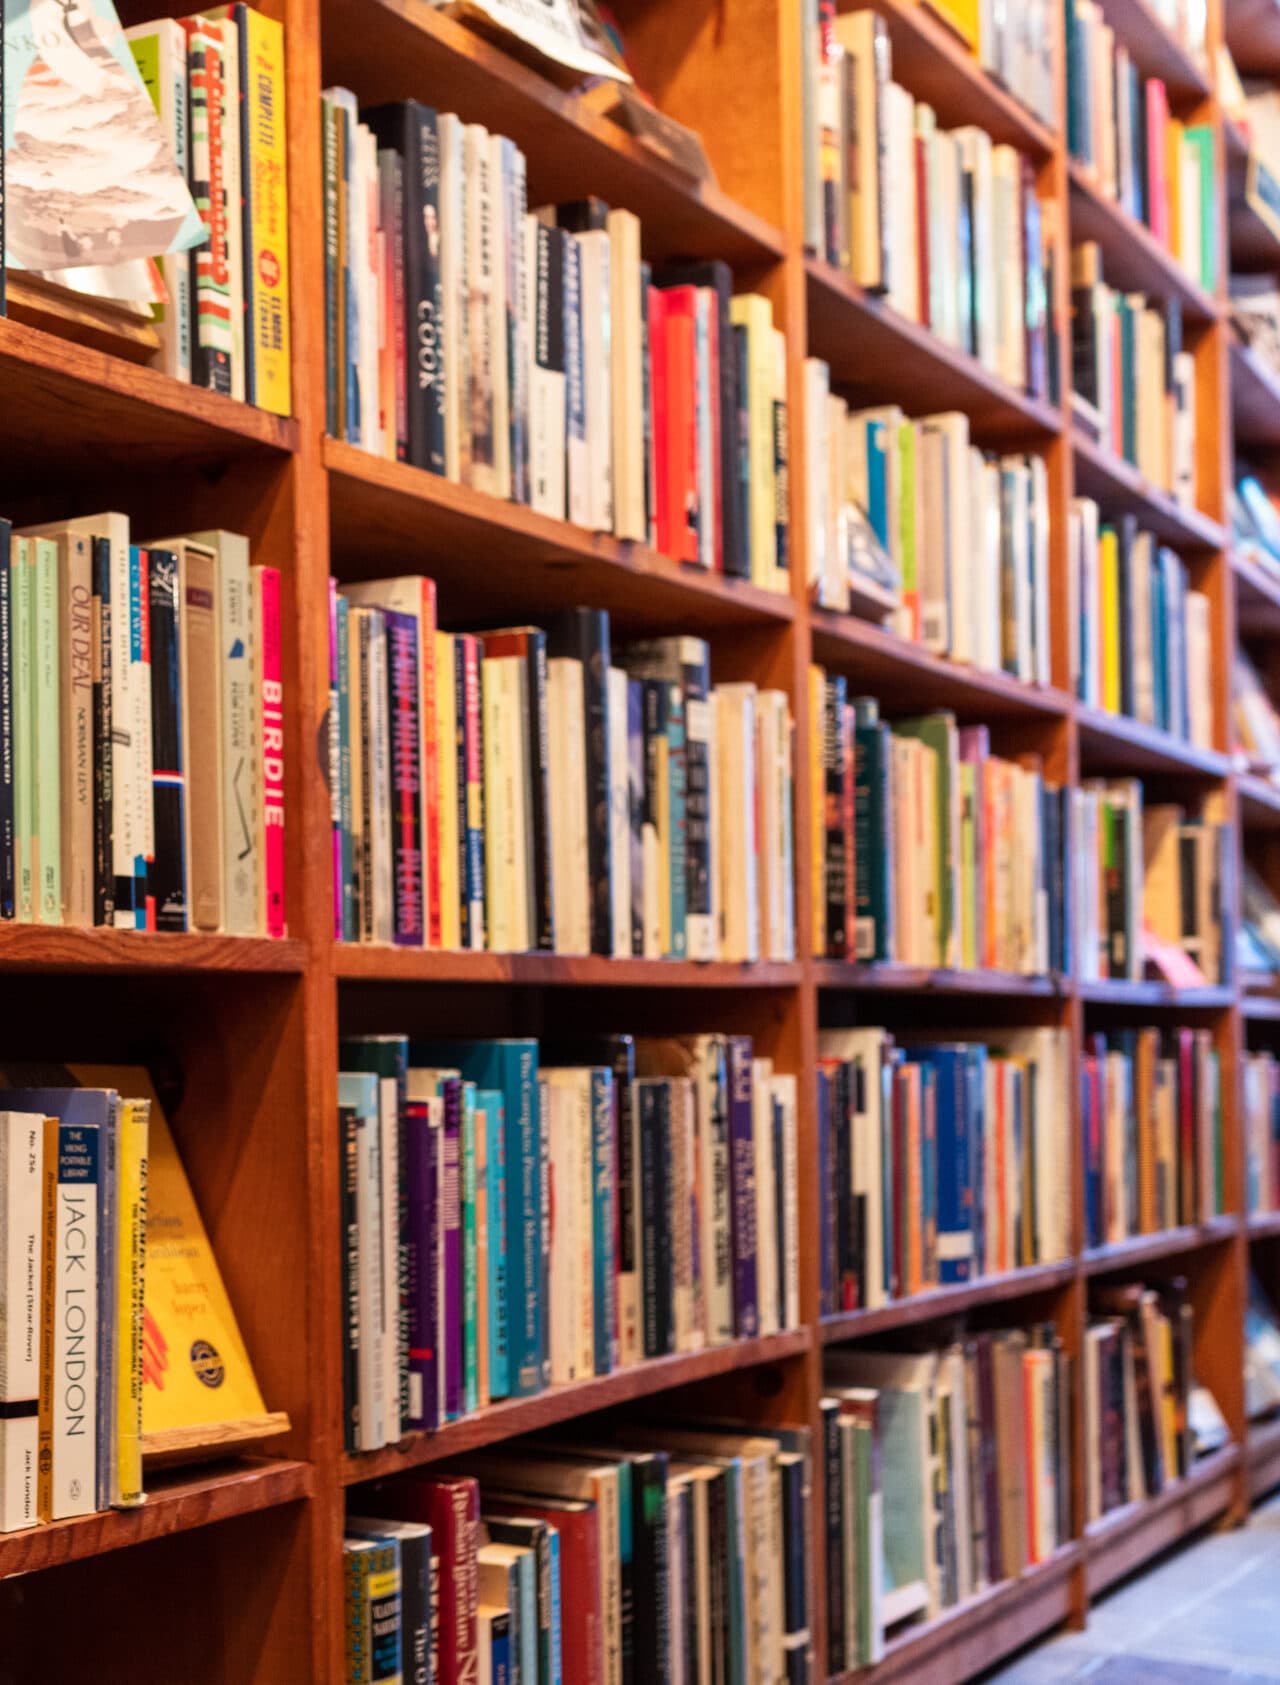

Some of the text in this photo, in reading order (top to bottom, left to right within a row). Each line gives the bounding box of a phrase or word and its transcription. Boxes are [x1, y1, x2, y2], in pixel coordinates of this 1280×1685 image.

[176, 82, 186, 155] CHINA
[418, 300, 435, 389] COOK
[72, 584, 91, 805] OUR DEAL NORMAN LEVY
[262, 680, 285, 827] BIRDIE
[394, 708, 418, 793] MILLER
[397, 847, 422, 935] PLEXUS
[28, 1129, 36, 1175] No. 256
[60, 1155, 92, 1167] PORTABLE
[64, 1142, 88, 1154] VIKING
[68, 1131, 84, 1142] THE
[62, 1167, 89, 1179] LIBRARY
[26, 1257, 35, 1293] Jacket
[27, 1234, 36, 1255] The
[62, 1191, 88, 1438] JACK LONDON
[24, 1449, 32, 1519] Jack London
